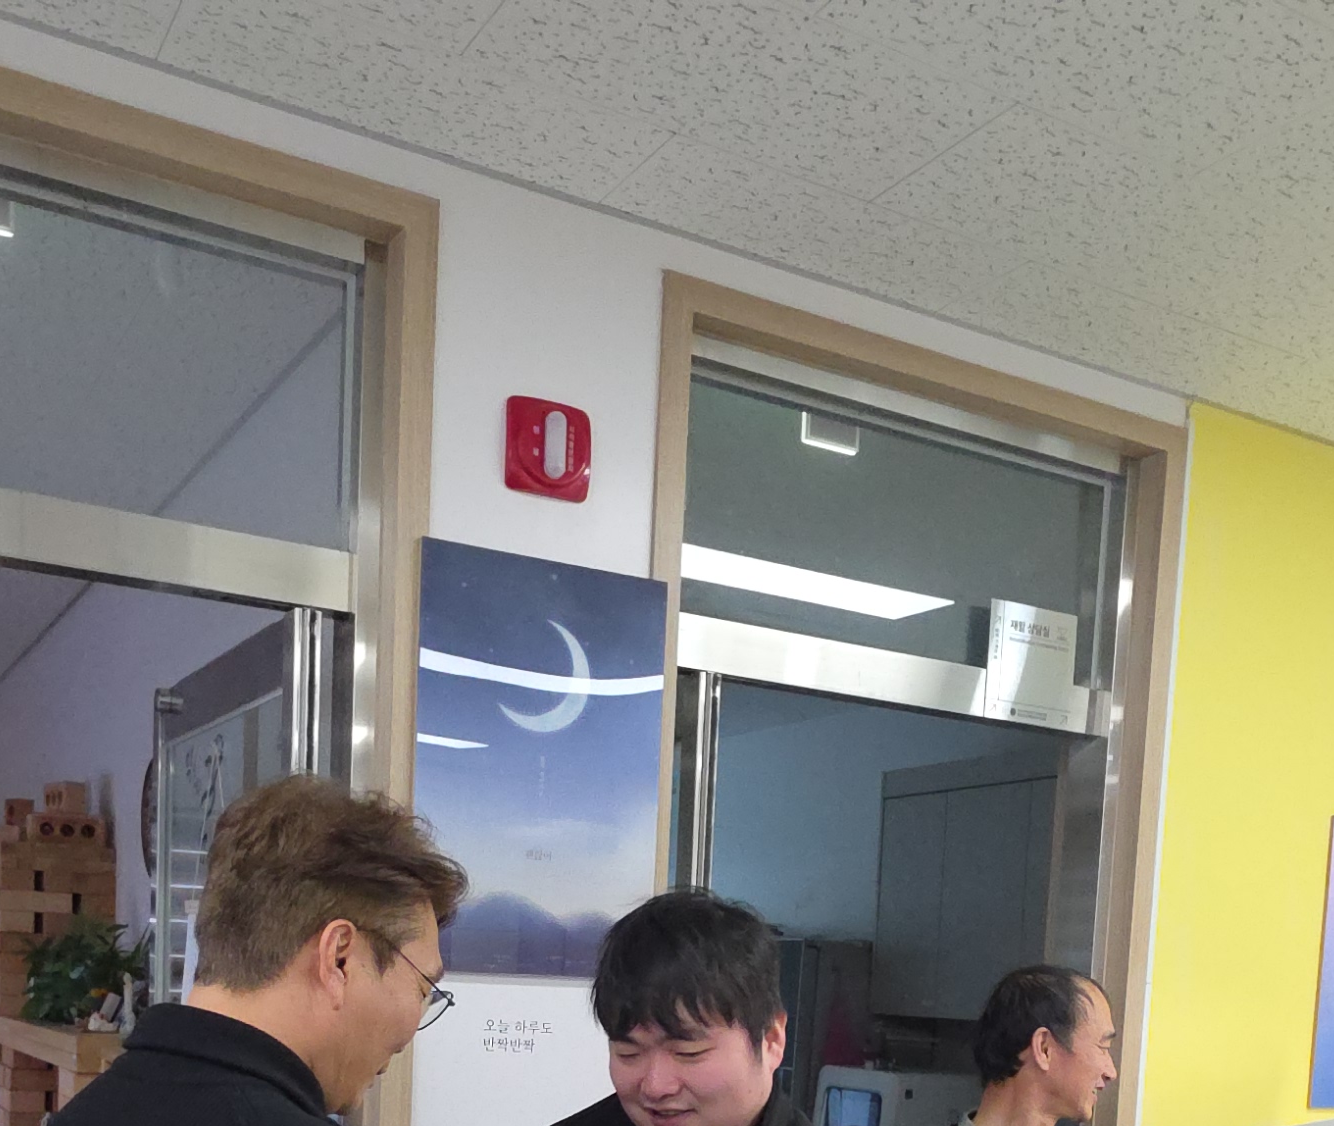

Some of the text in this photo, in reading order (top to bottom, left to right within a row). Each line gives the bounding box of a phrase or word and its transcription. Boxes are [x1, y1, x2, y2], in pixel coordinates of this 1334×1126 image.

[483, 1019, 553, 1035] 오늘 하루도
[483, 1036, 535, 1054] 반짝반짝
